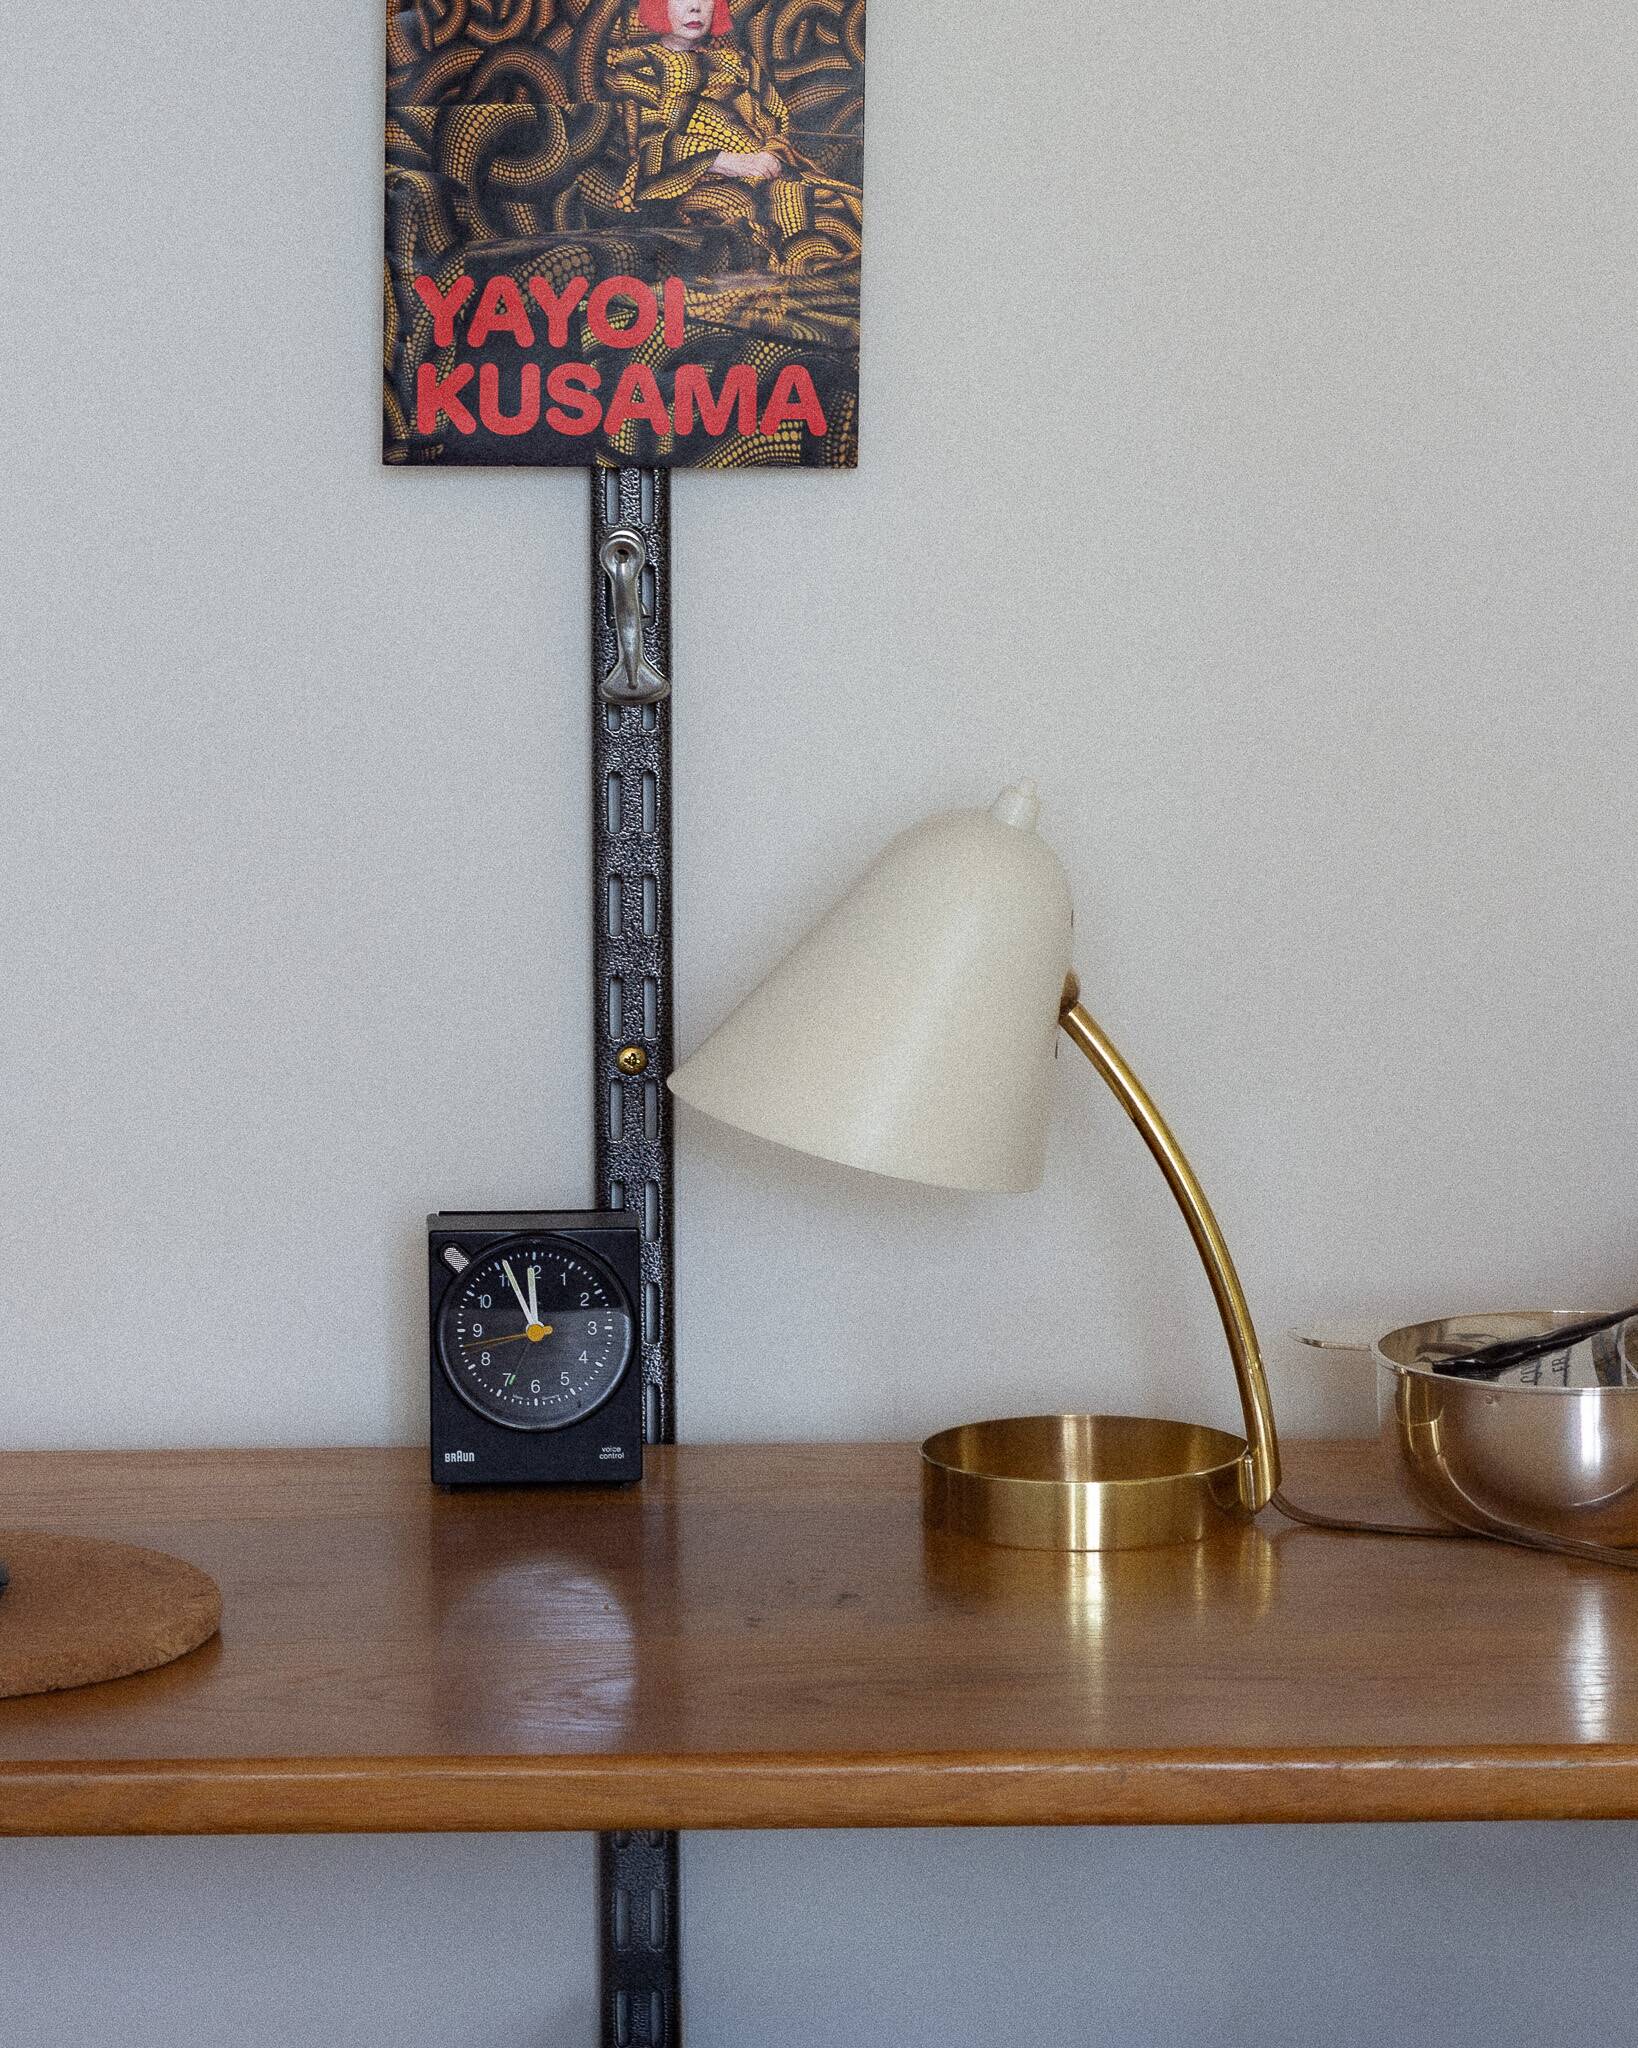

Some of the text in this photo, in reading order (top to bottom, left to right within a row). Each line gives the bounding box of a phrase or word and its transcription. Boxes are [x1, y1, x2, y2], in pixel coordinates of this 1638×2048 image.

[412, 275, 685, 349] YAYOI
[416, 362, 828, 437] KUSAMA
[560, 1272, 567, 1287] 1
[478, 1294, 492, 1309] 10
[579, 1292, 590, 1307] 2
[472, 1323, 483, 1338] 9
[587, 1320, 598, 1335] 3
[481, 1351, 491, 1366] 8
[578, 1350, 588, 1364] 4
[502, 1372, 512, 1387] 7
[559, 1371, 570, 1386] 5
[530, 1379, 541, 1394] 6
[444, 1450, 475, 1463] BRAUN
[599, 1452, 625, 1460] control
[601, 1445, 622, 1453] voice
